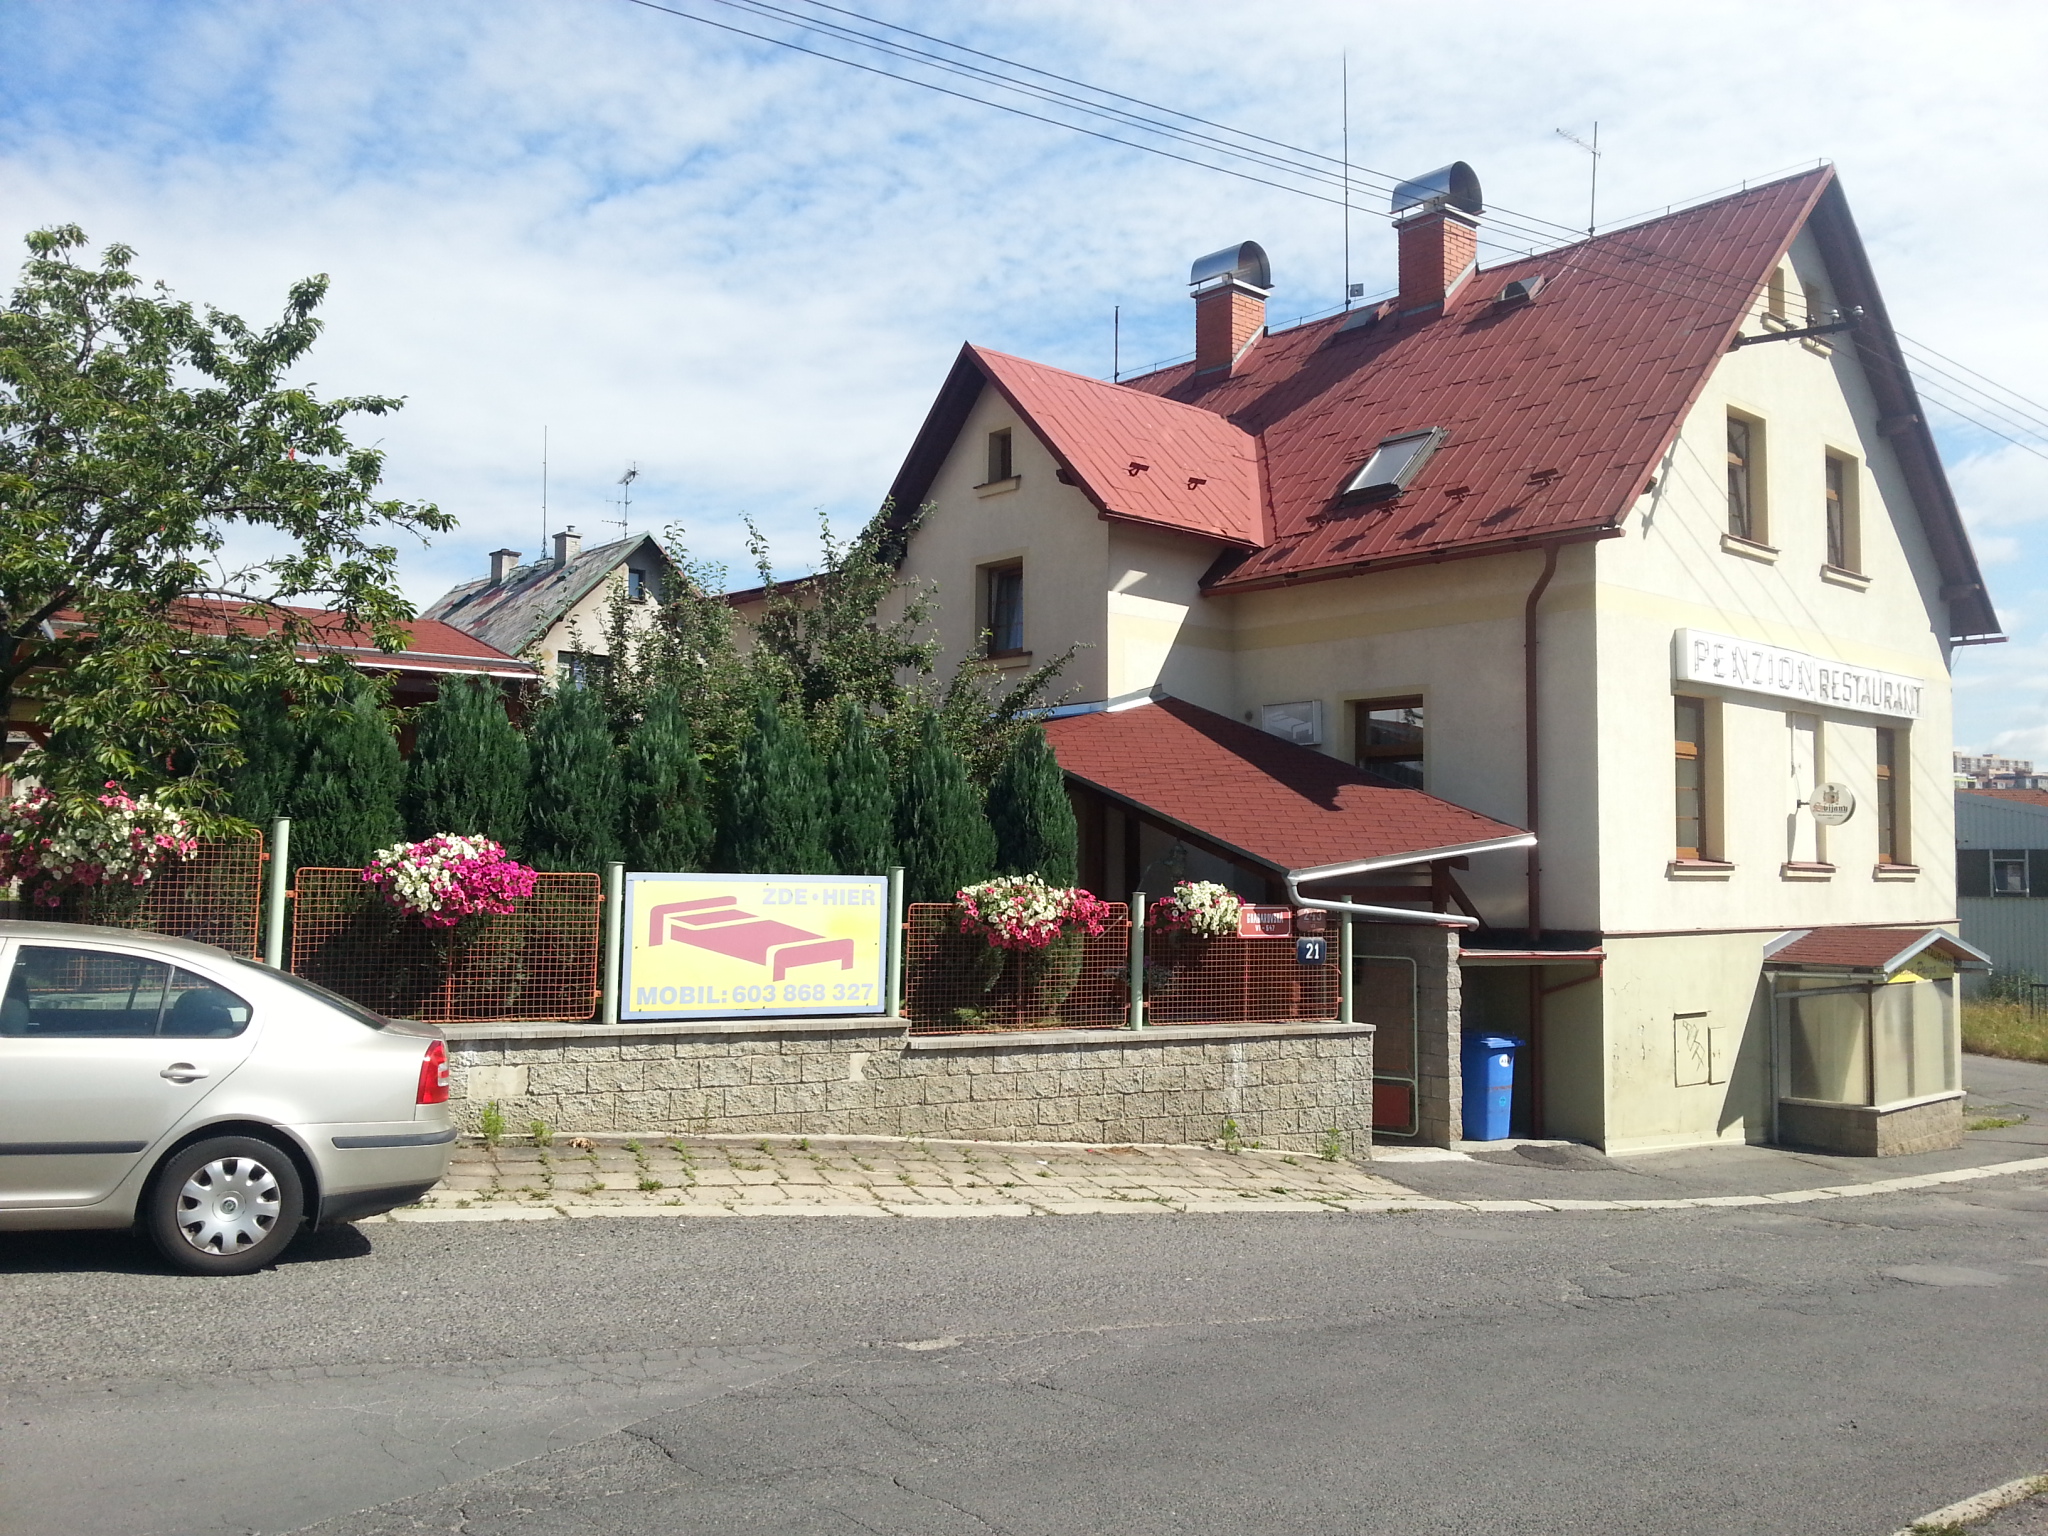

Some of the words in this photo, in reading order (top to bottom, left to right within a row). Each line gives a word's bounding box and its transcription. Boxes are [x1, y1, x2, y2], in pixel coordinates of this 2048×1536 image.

[1694, 639, 1815, 696] PENZION
[1819, 668, 1924, 715] RESTAURANT
[762, 888, 808, 905] ZDE
[823, 889, 876, 906] HIER
[1306, 943, 1320, 960] 21
[636, 986, 728, 1005] MOBIL:
[732, 985, 776, 1003] 603
[783, 984, 825, 1002] 868
[833, 983, 874, 1001] 327
